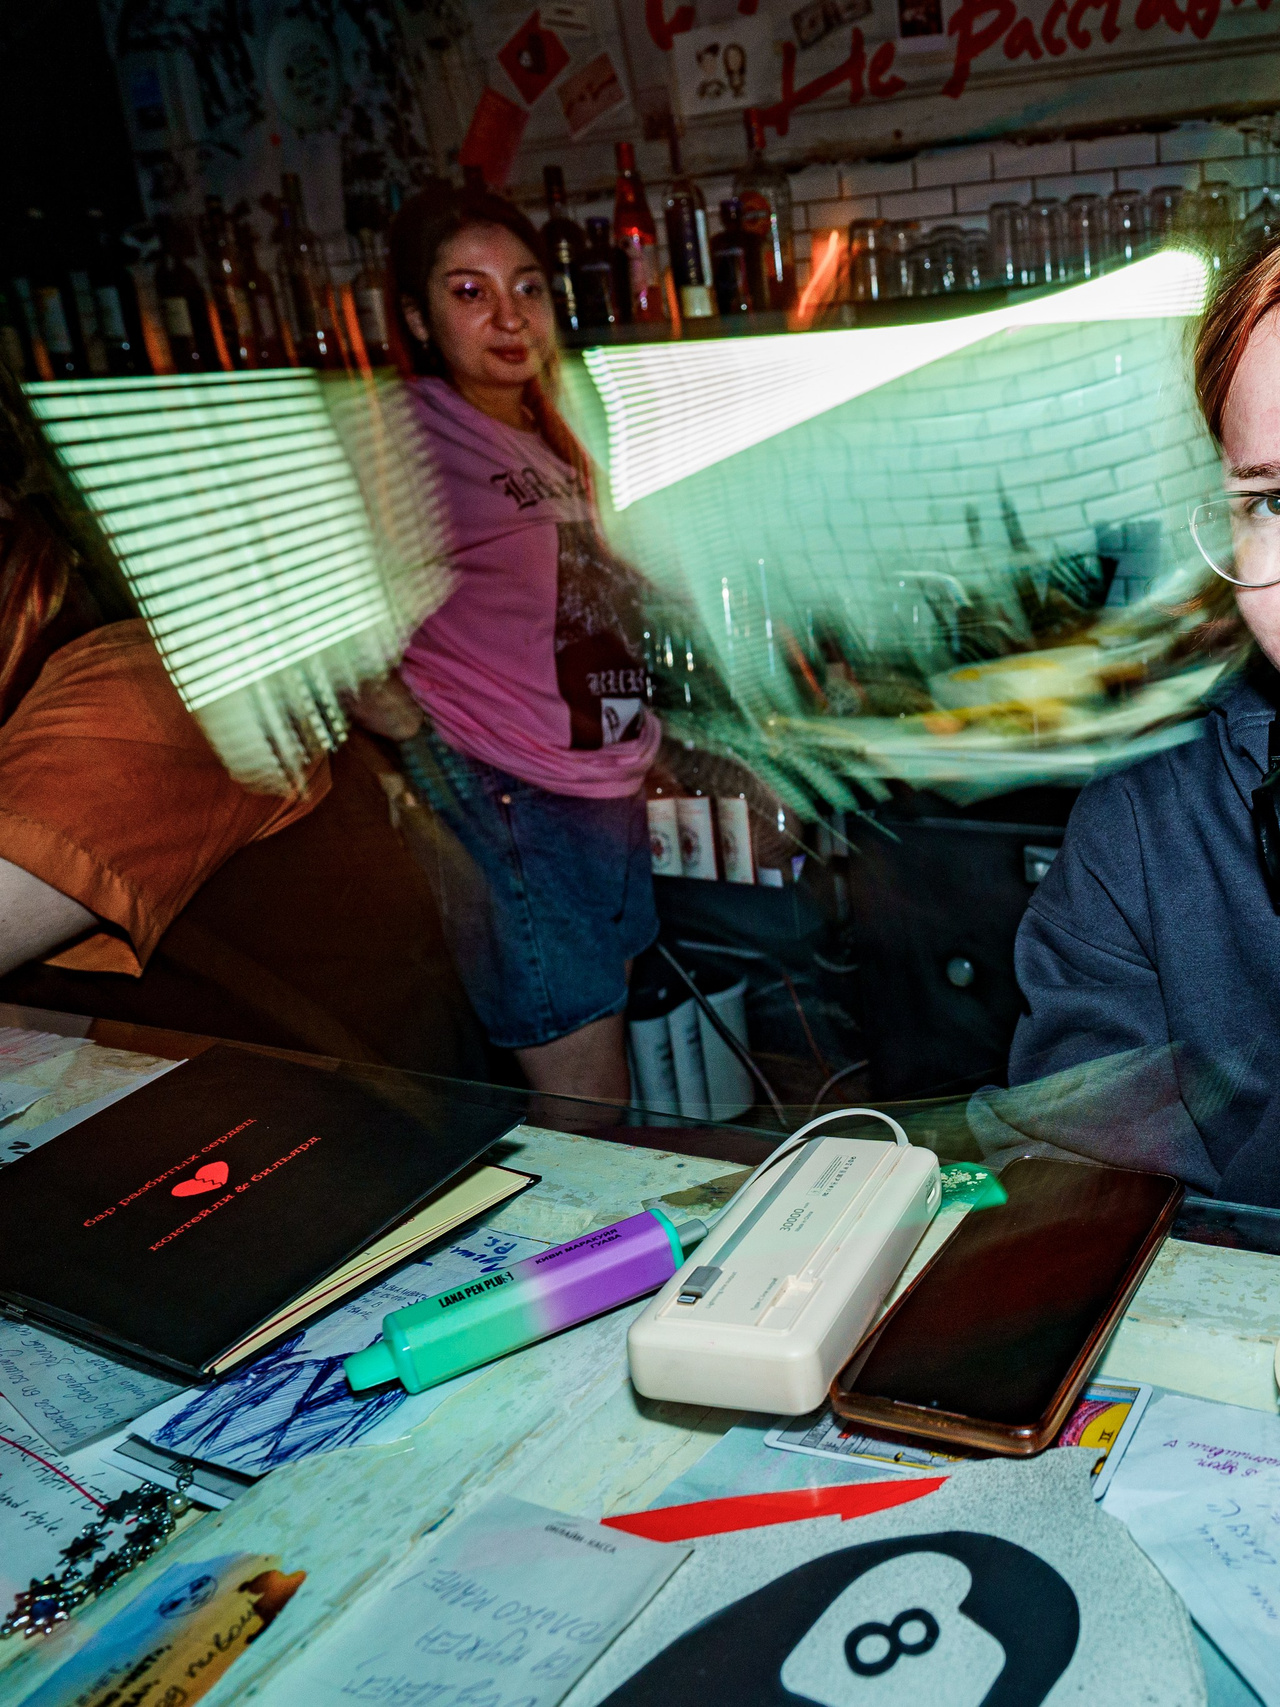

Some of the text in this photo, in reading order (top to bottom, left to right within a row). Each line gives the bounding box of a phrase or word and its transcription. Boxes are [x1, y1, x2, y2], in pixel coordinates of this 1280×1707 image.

[84, 1119, 256, 1227] бар разбитых сердец
[150, 1137, 321, 1251] коктейли & бильярд
[780, 1209, 804, 1231] 30000
[534, 1229, 617, 1264] КИВИ МАРАКУЙЯ
[591, 1234, 621, 1248] ГУАВА
[439, 1292, 465, 1308] LANA
[465, 1284, 484, 1297] PEN
[844, 1607, 940, 1677] 8
